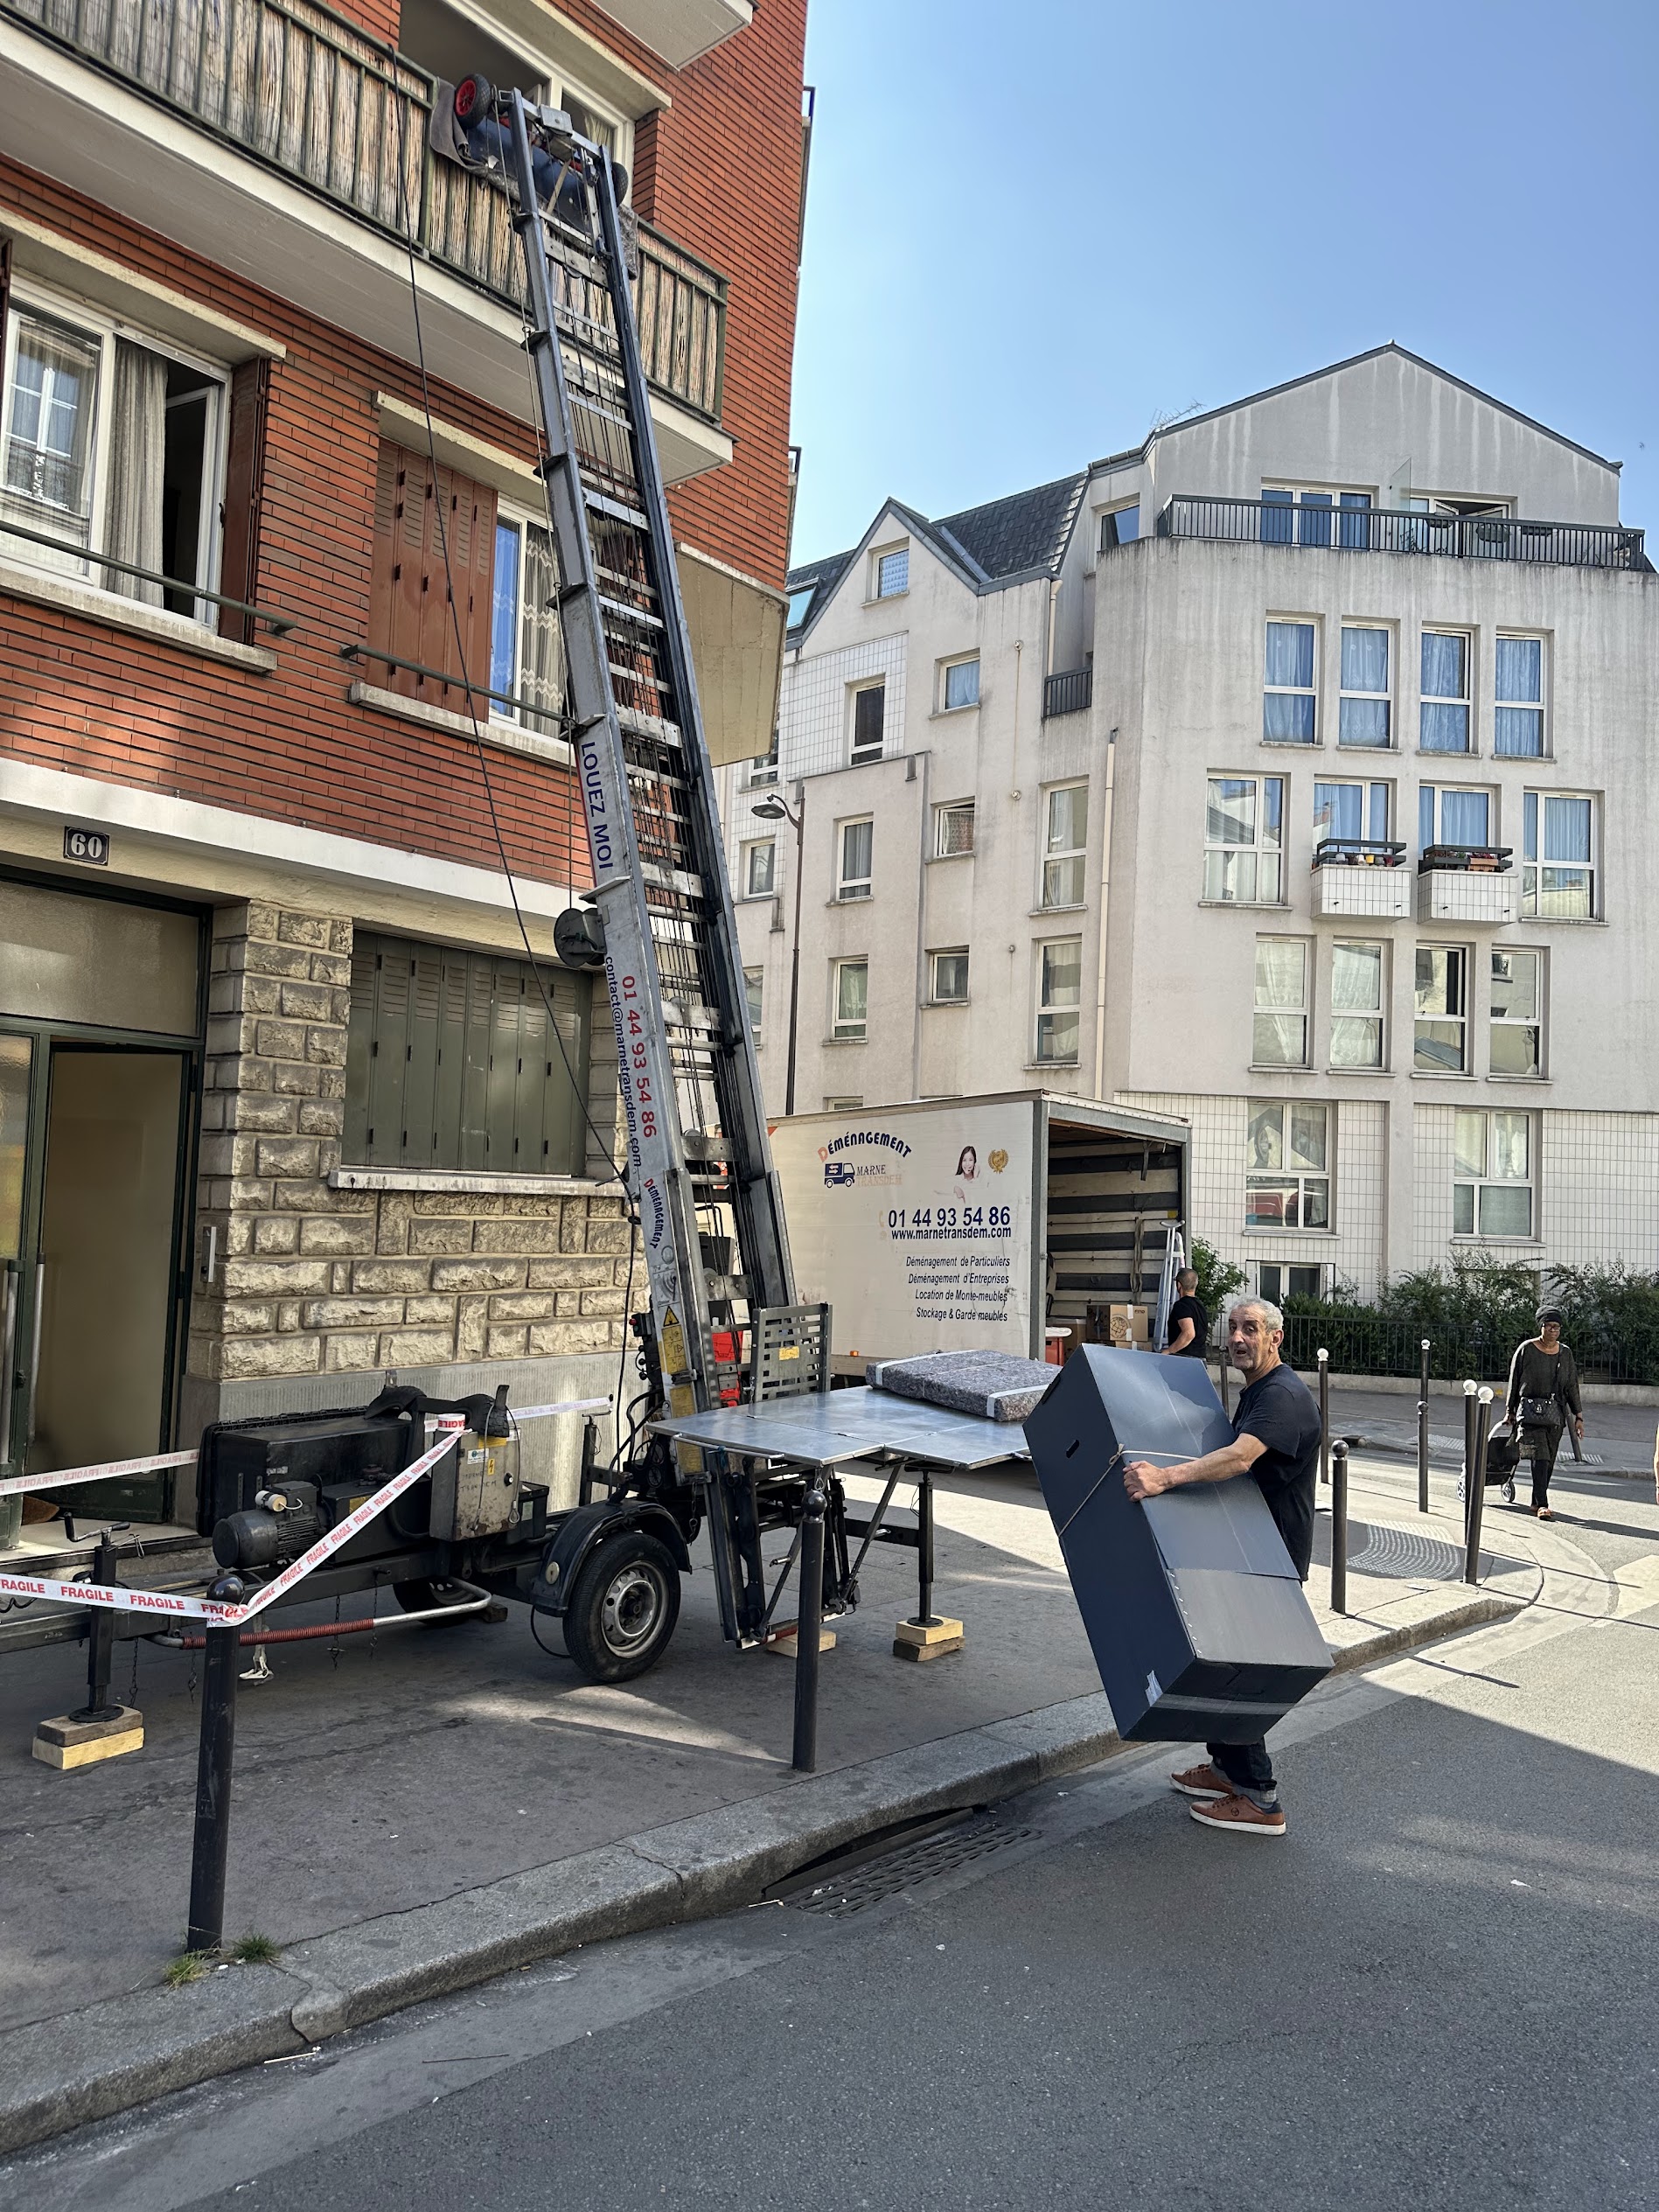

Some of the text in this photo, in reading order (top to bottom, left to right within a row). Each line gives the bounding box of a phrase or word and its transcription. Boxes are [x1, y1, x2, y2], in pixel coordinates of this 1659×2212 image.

[581, 742, 614, 869] LOUEZ MOI
[71, 834, 102, 858] 60
[605, 956, 642, 1167] contact@marnetransdem.com
[622, 975, 657, 1138] 01 44 93 54 86
[856, 1164, 887, 1176] MARNE
[888, 1206, 1011, 1228] 01 44 93 54 86
[891, 1226, 1011, 1239] www.marnetransdem.com
[906, 1255, 1010, 1268] Déménagement de Particuliers
[908, 1273, 1009, 1286] Déménagement d'Entreprises
[915, 1289, 1007, 1301] Location de Monte-meubles
[917, 1307, 1007, 1321] Stockage & Garde meubles
[393, 1475, 412, 1491] FRAGILE
[373, 1490, 394, 1507] FRAGILE
[353, 1506, 374, 1525] FRAGILE
[331, 1524, 352, 1545] FRAGILE
[306, 1543, 330, 1566] FRAGILE
[280, 1562, 303, 1587] FRAGILE
[0, 1579, 45, 1594] RAGILE
[60, 1586, 115, 1601] FRAGILE
[130, 1594, 185, 1610] FRAGILE
